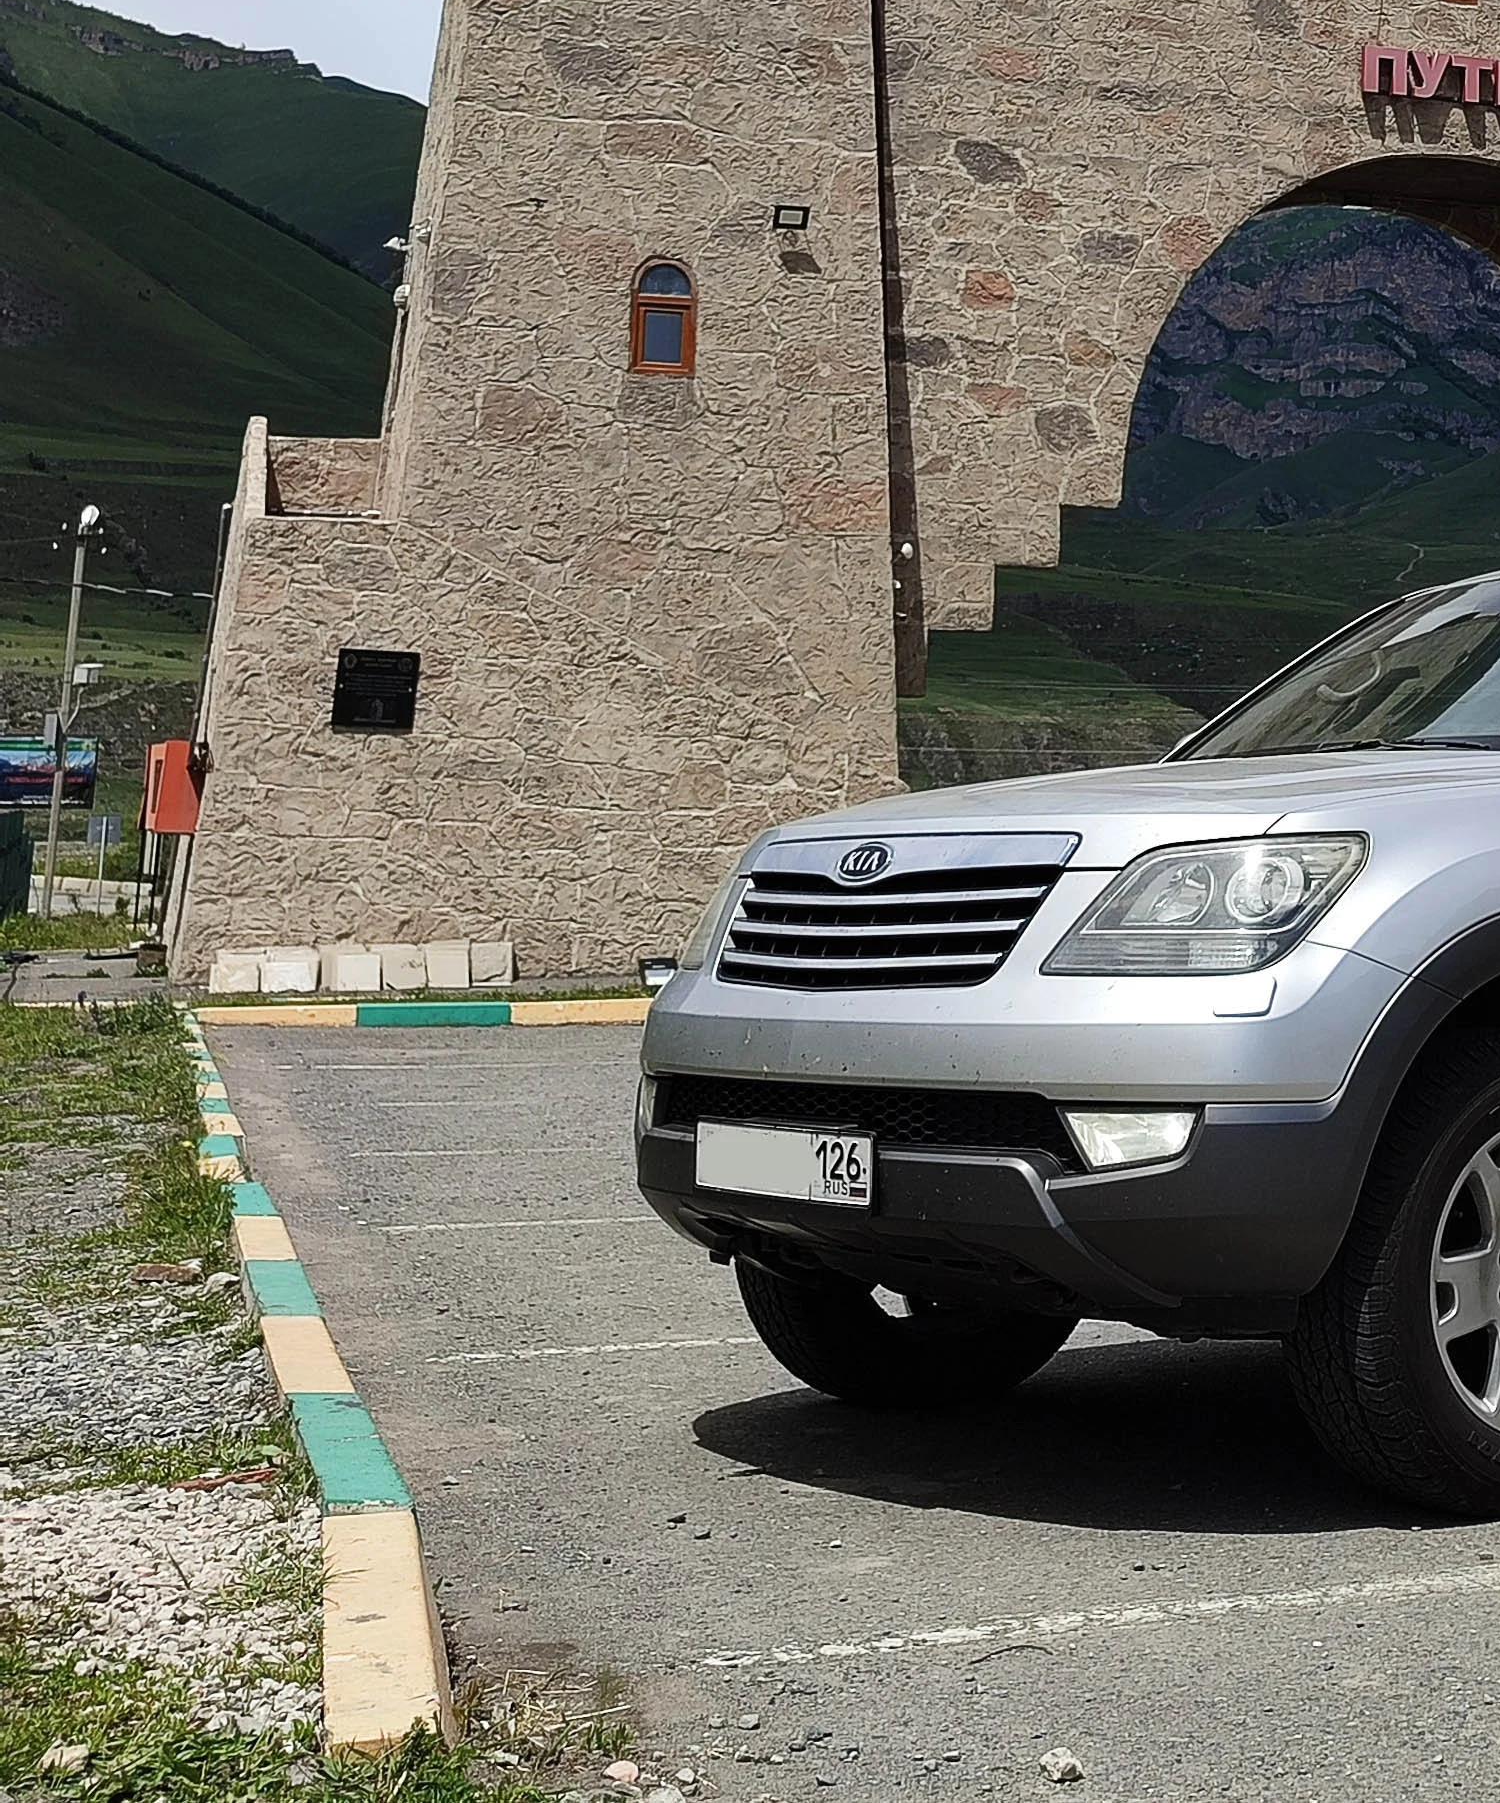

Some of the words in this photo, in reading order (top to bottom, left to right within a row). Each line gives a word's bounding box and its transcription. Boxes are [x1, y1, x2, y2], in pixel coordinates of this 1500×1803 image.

[842, 850, 881, 871] KIA
[815, 1140, 862, 1181] 126
[823, 1179, 848, 1196] RUS
